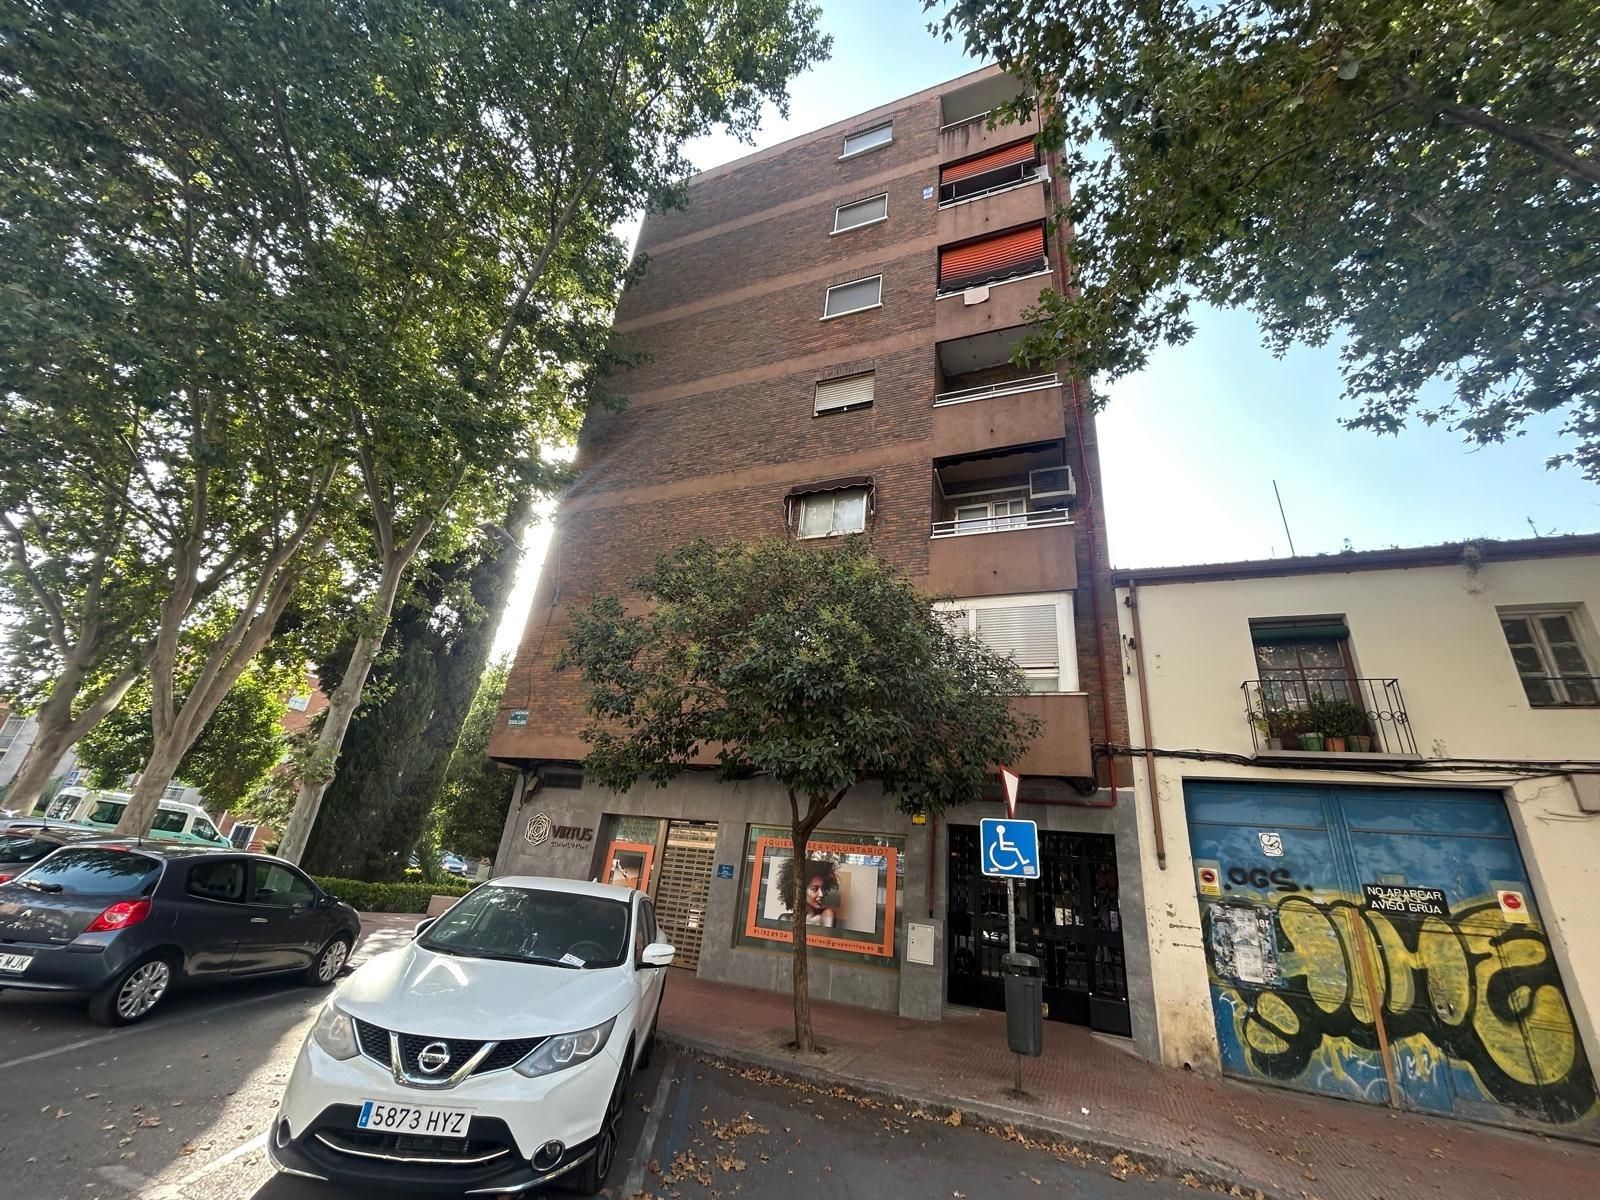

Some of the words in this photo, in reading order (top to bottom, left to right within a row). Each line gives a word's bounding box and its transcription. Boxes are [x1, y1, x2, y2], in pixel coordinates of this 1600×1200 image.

[552, 825, 593, 841] VIRTUS
[808, 842, 823, 850] SER
[826, 844, 889, 855] VOLUNTARIO?
[1367, 886, 1384, 896] NO
[1371, 900, 1405, 911] AVISO
[373, 1106, 422, 1130] 5873
[426, 1111, 465, 1133] HYZ
